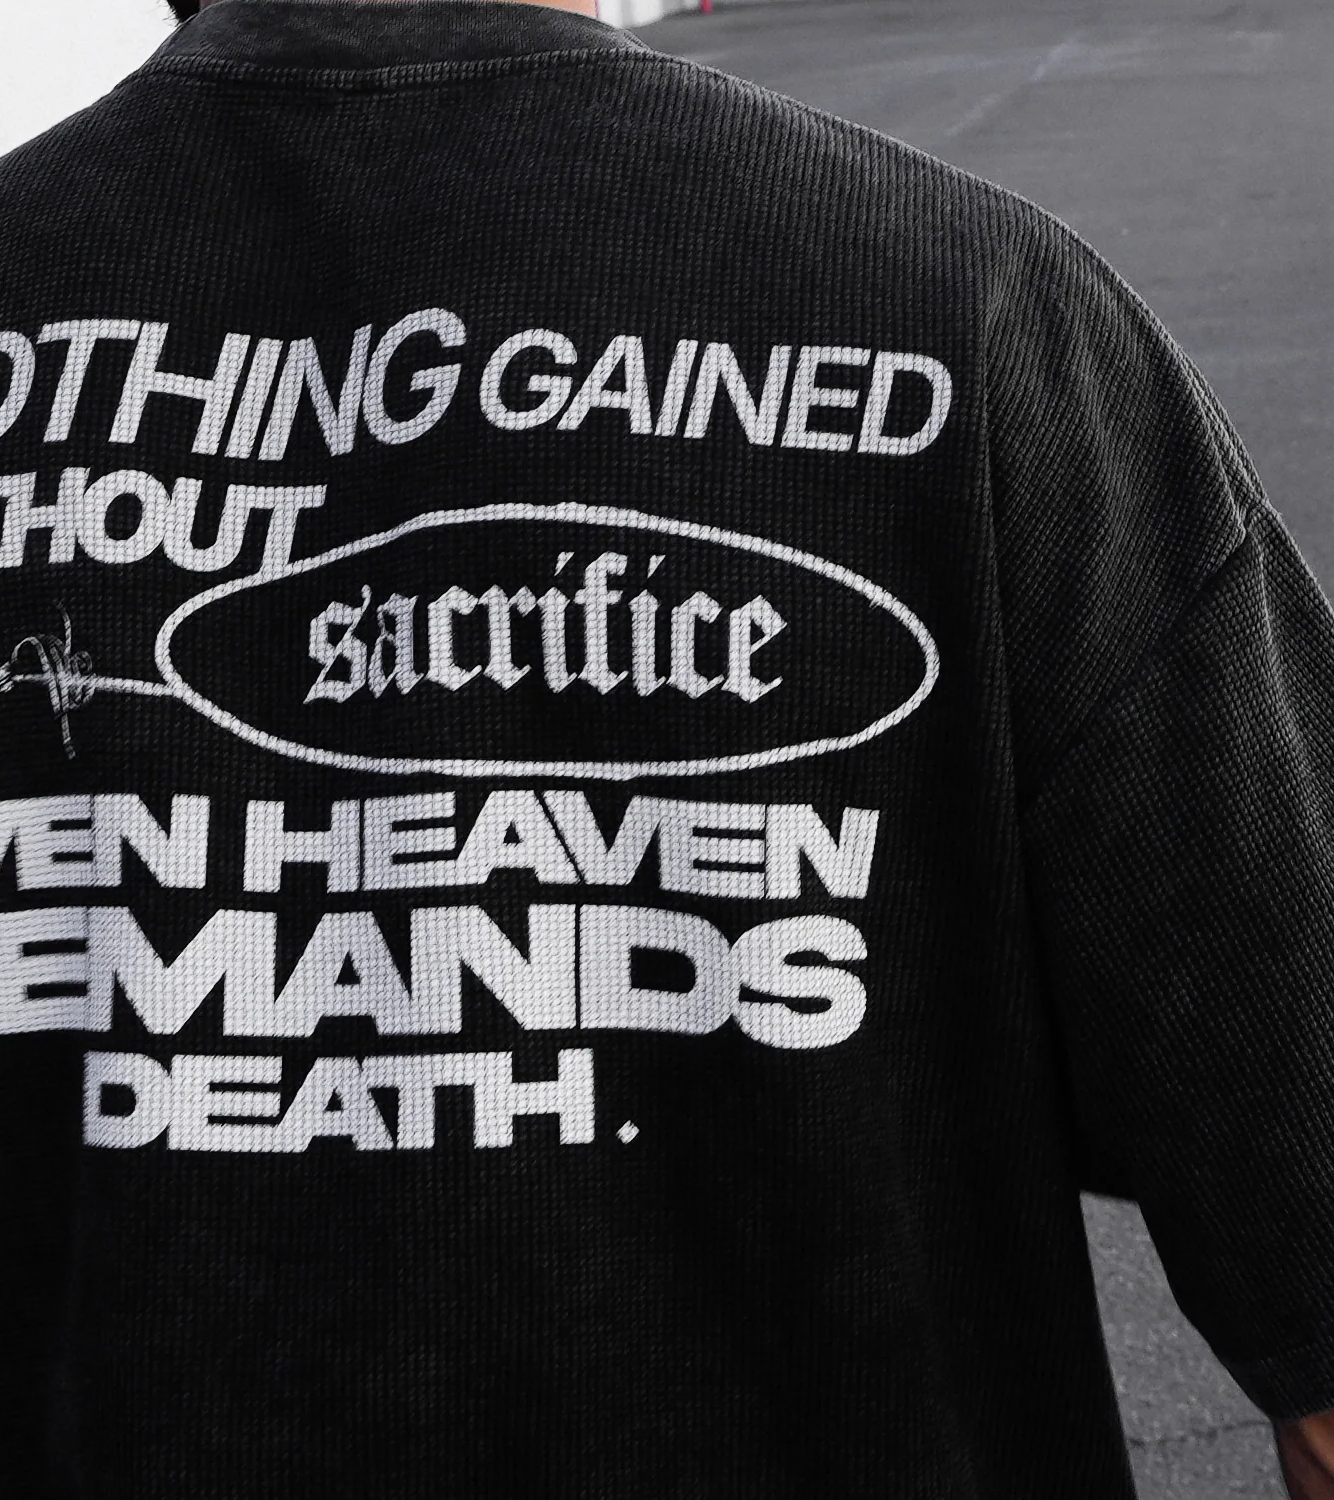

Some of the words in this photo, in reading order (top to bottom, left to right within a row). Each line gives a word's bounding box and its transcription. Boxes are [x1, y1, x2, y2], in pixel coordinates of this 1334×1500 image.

[478, 327, 953, 457] GAINED
[304, 551, 788, 706] sacrifice
[243, 790, 880, 900] HEAVEN
